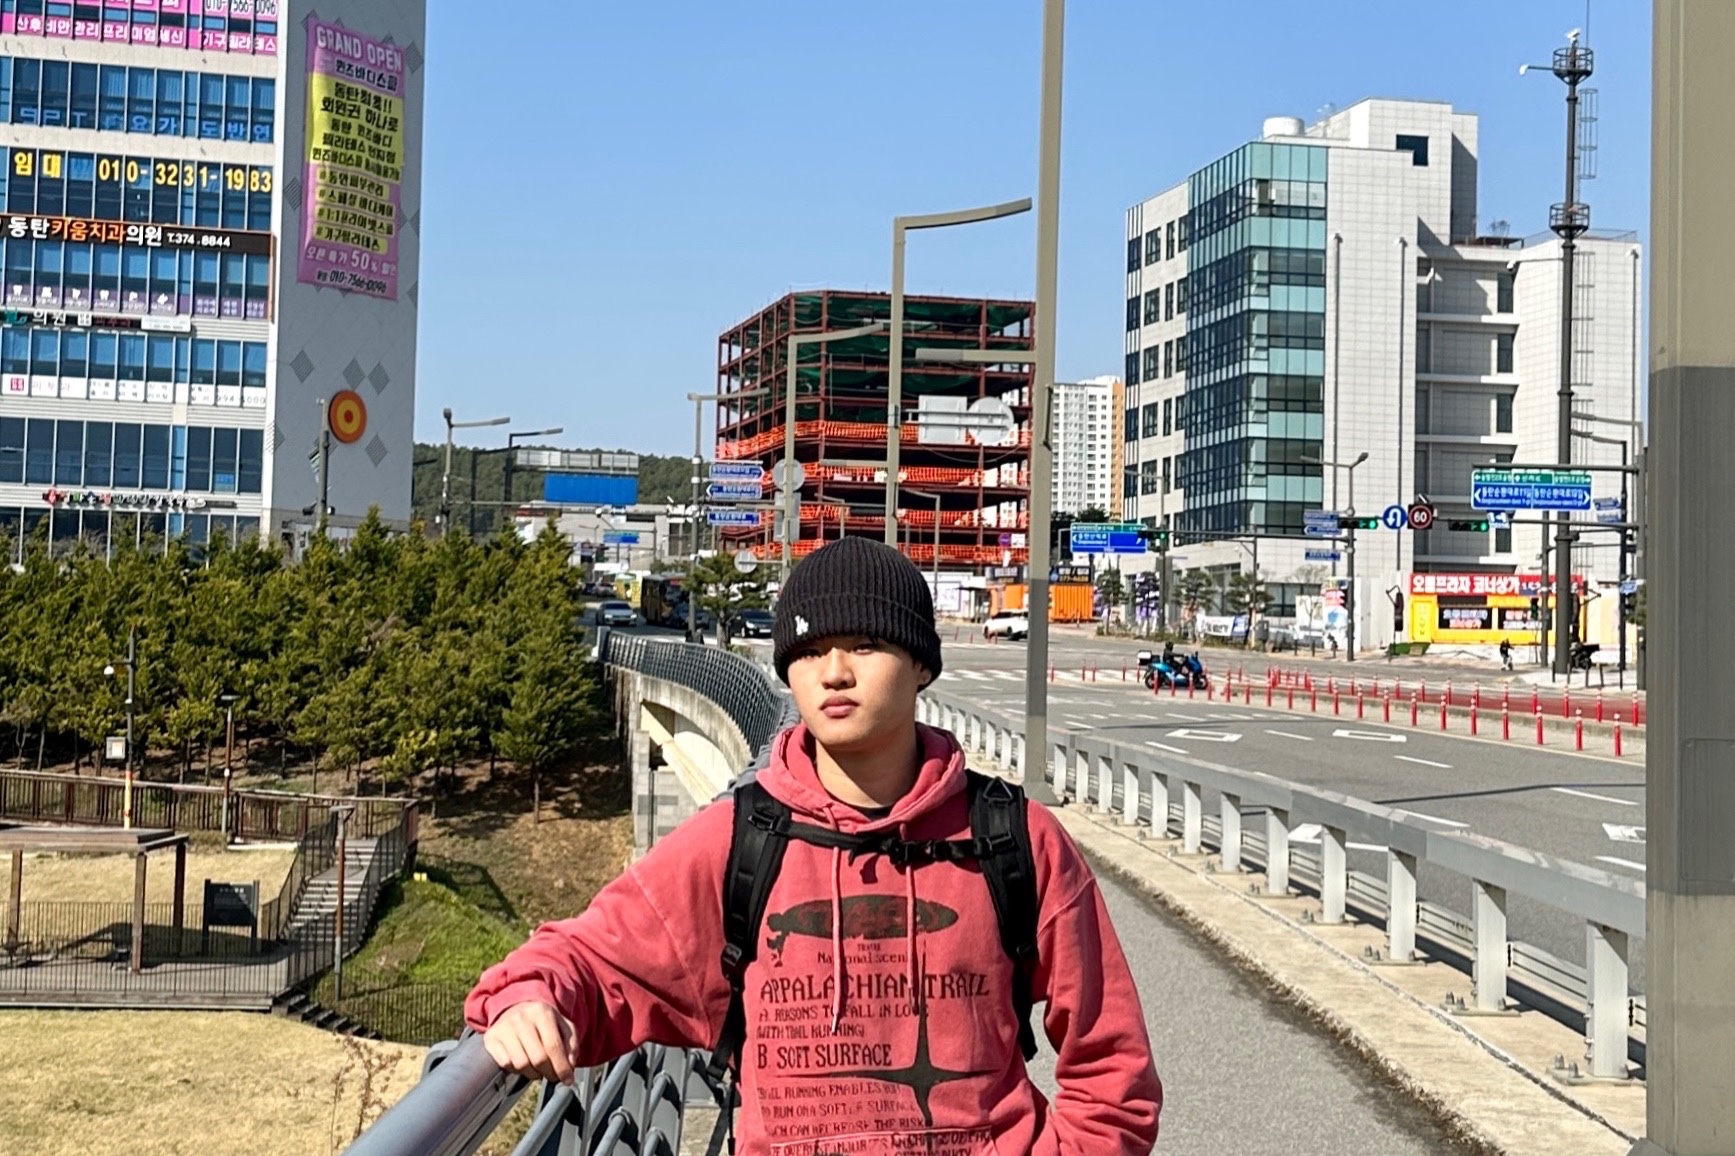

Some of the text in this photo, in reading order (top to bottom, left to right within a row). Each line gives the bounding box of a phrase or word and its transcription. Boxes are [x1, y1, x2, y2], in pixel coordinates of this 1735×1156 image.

[316, 26, 362, 60] GRAND
[366, 43, 402, 72] OPEN
[365, 108, 399, 132] 하나로
[14, 151, 61, 179] 임대
[33, 310, 67, 326] 의원
[1414, 510, 1428, 523] 60
[923, 972, 990, 999] TRAIL
[776, 1045, 810, 1069] SOFT
[814, 1042, 893, 1068] SURFACE
